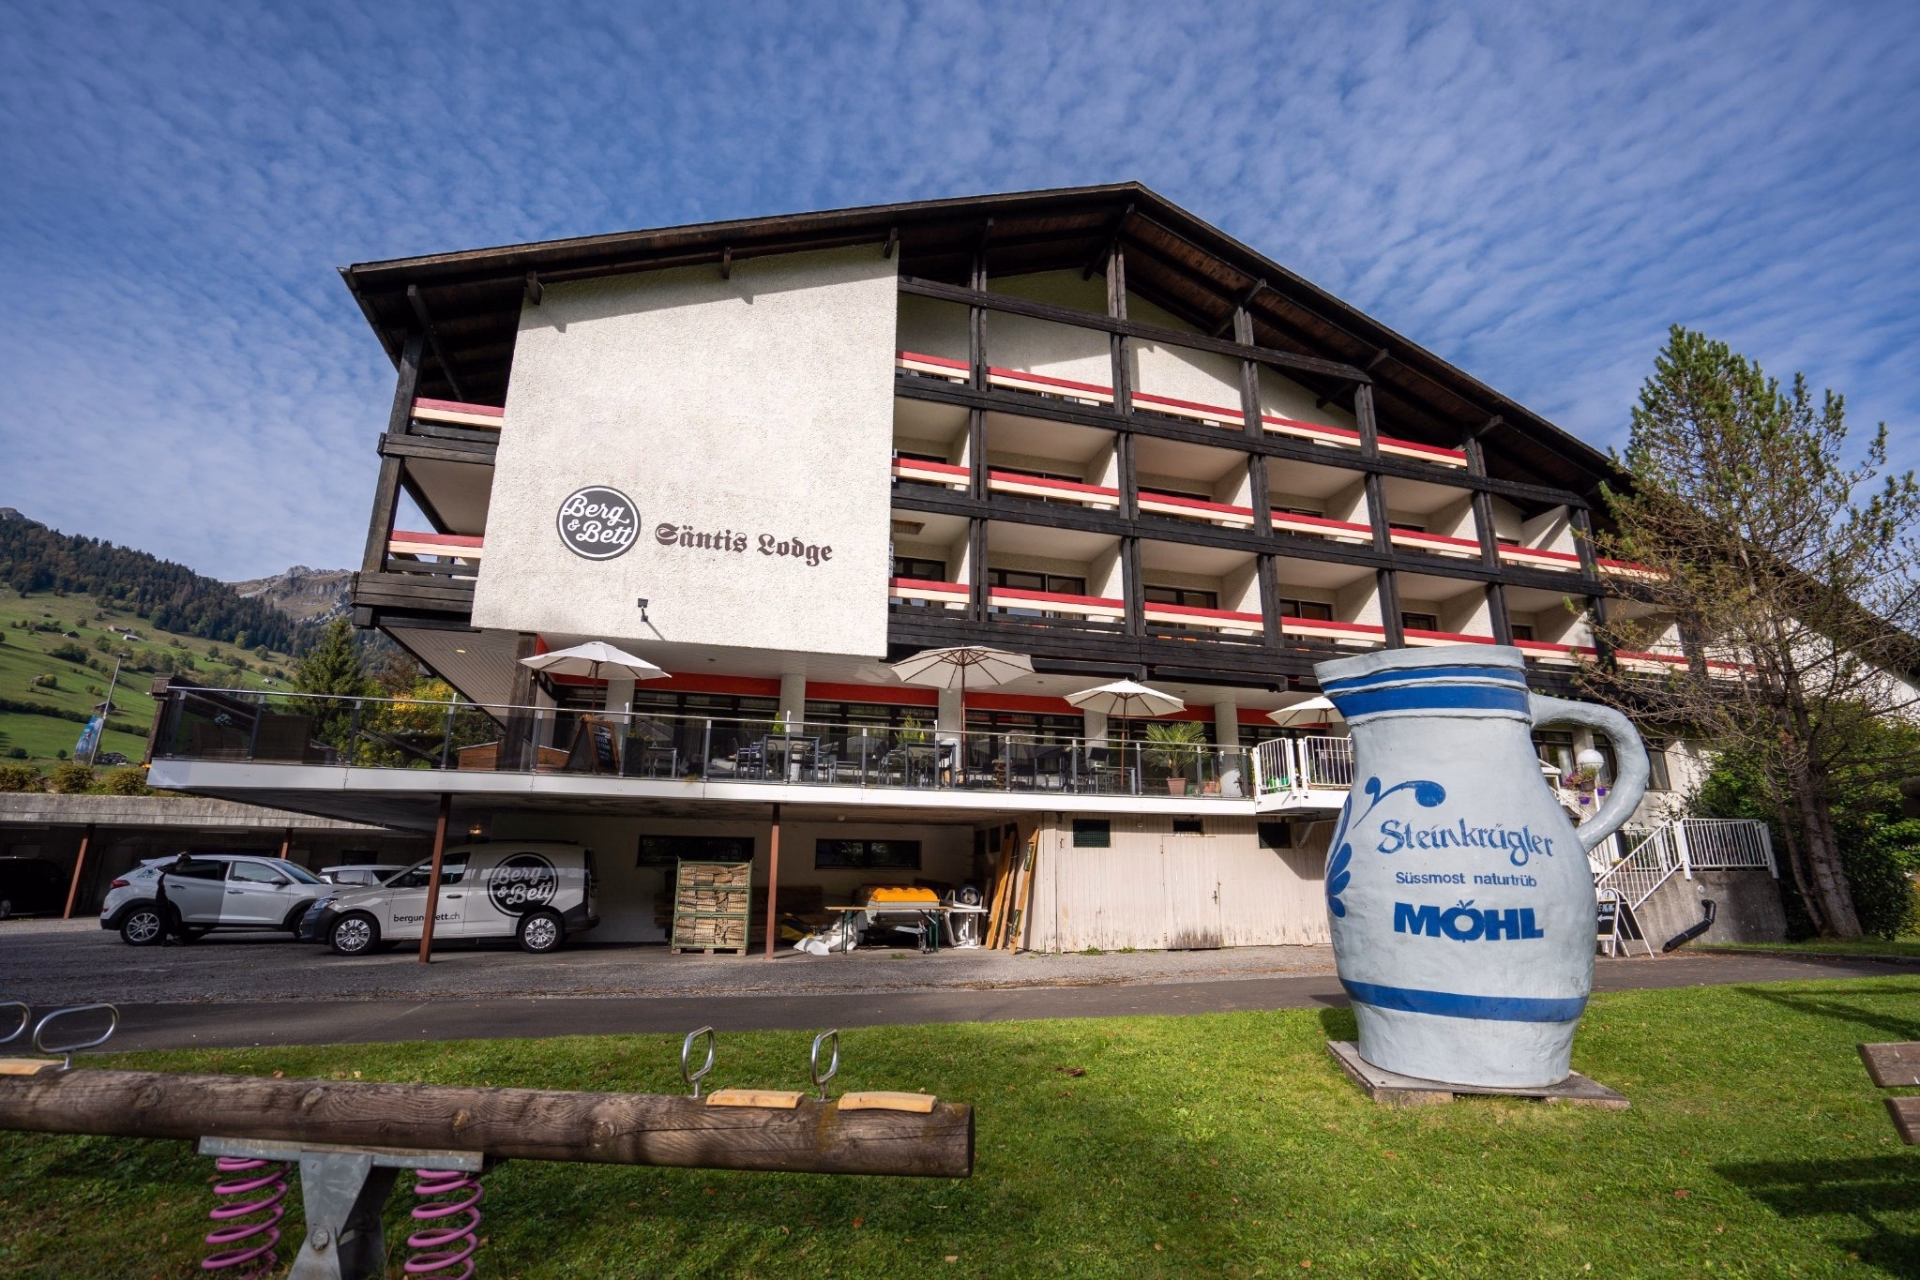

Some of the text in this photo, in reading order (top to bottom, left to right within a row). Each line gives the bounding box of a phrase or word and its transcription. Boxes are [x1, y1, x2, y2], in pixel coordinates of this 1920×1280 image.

[561, 494, 630, 526] Berg
[566, 519, 633, 545] & Bett
[655, 522, 833, 567] Säntis Lodge
[1376, 818, 1554, 867] Steinkrügler
[491, 865, 550, 885] Berg
[1395, 872, 1538, 887] Süssmost naturtrüb
[497, 883, 553, 905] & Bett
[393, 912, 461, 924] bergunett.ch
